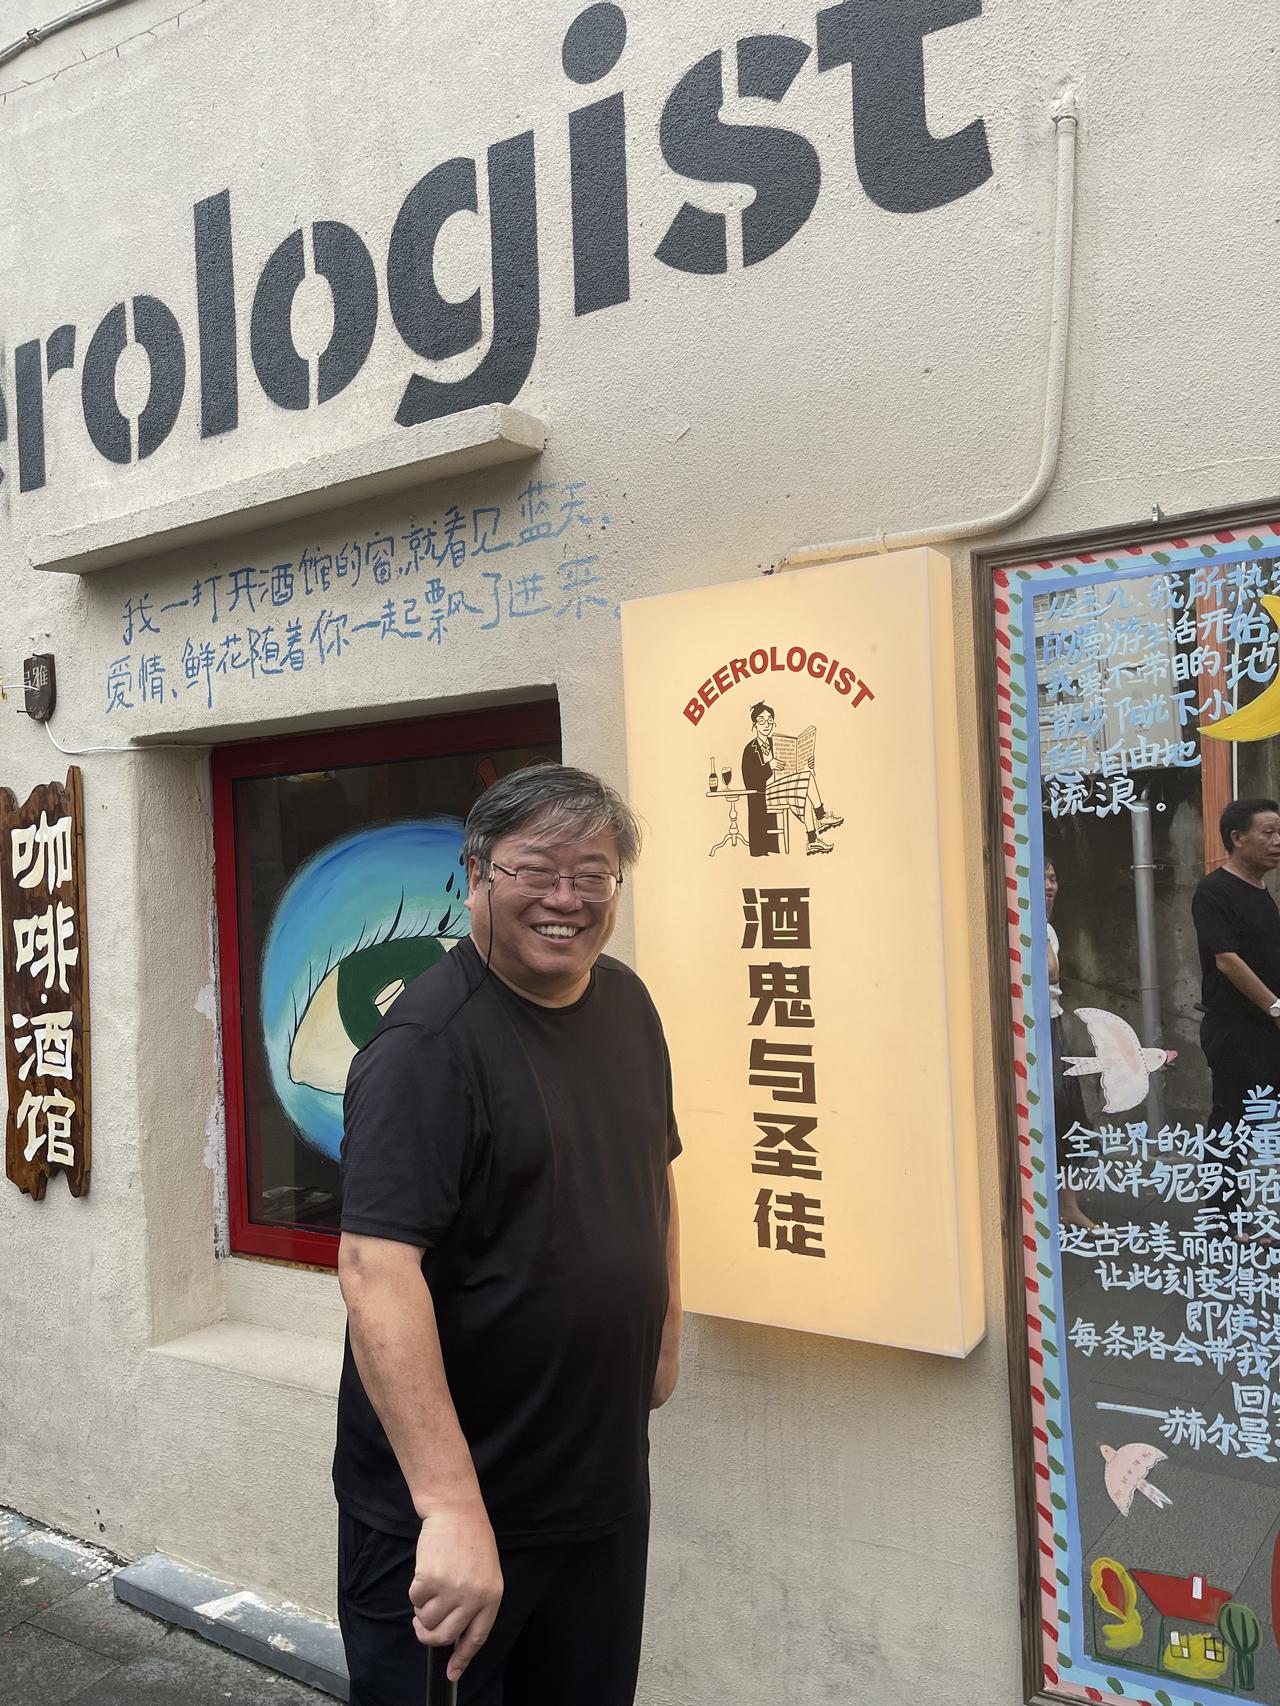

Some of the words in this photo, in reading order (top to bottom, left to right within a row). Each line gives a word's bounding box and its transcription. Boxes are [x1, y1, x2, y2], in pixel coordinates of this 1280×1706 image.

[0, 0, 993, 493] rologist
[683, 646, 875, 727] BEEROLOGIST
[1050, 777, 1166, 818] 流浪。
[741, 888, 826, 1259] 酒鬼与圣徒
[1056, 1220, 1280, 1281] 这古老美丽的比
[1068, 1316, 1280, 1382] 每条路会带我
